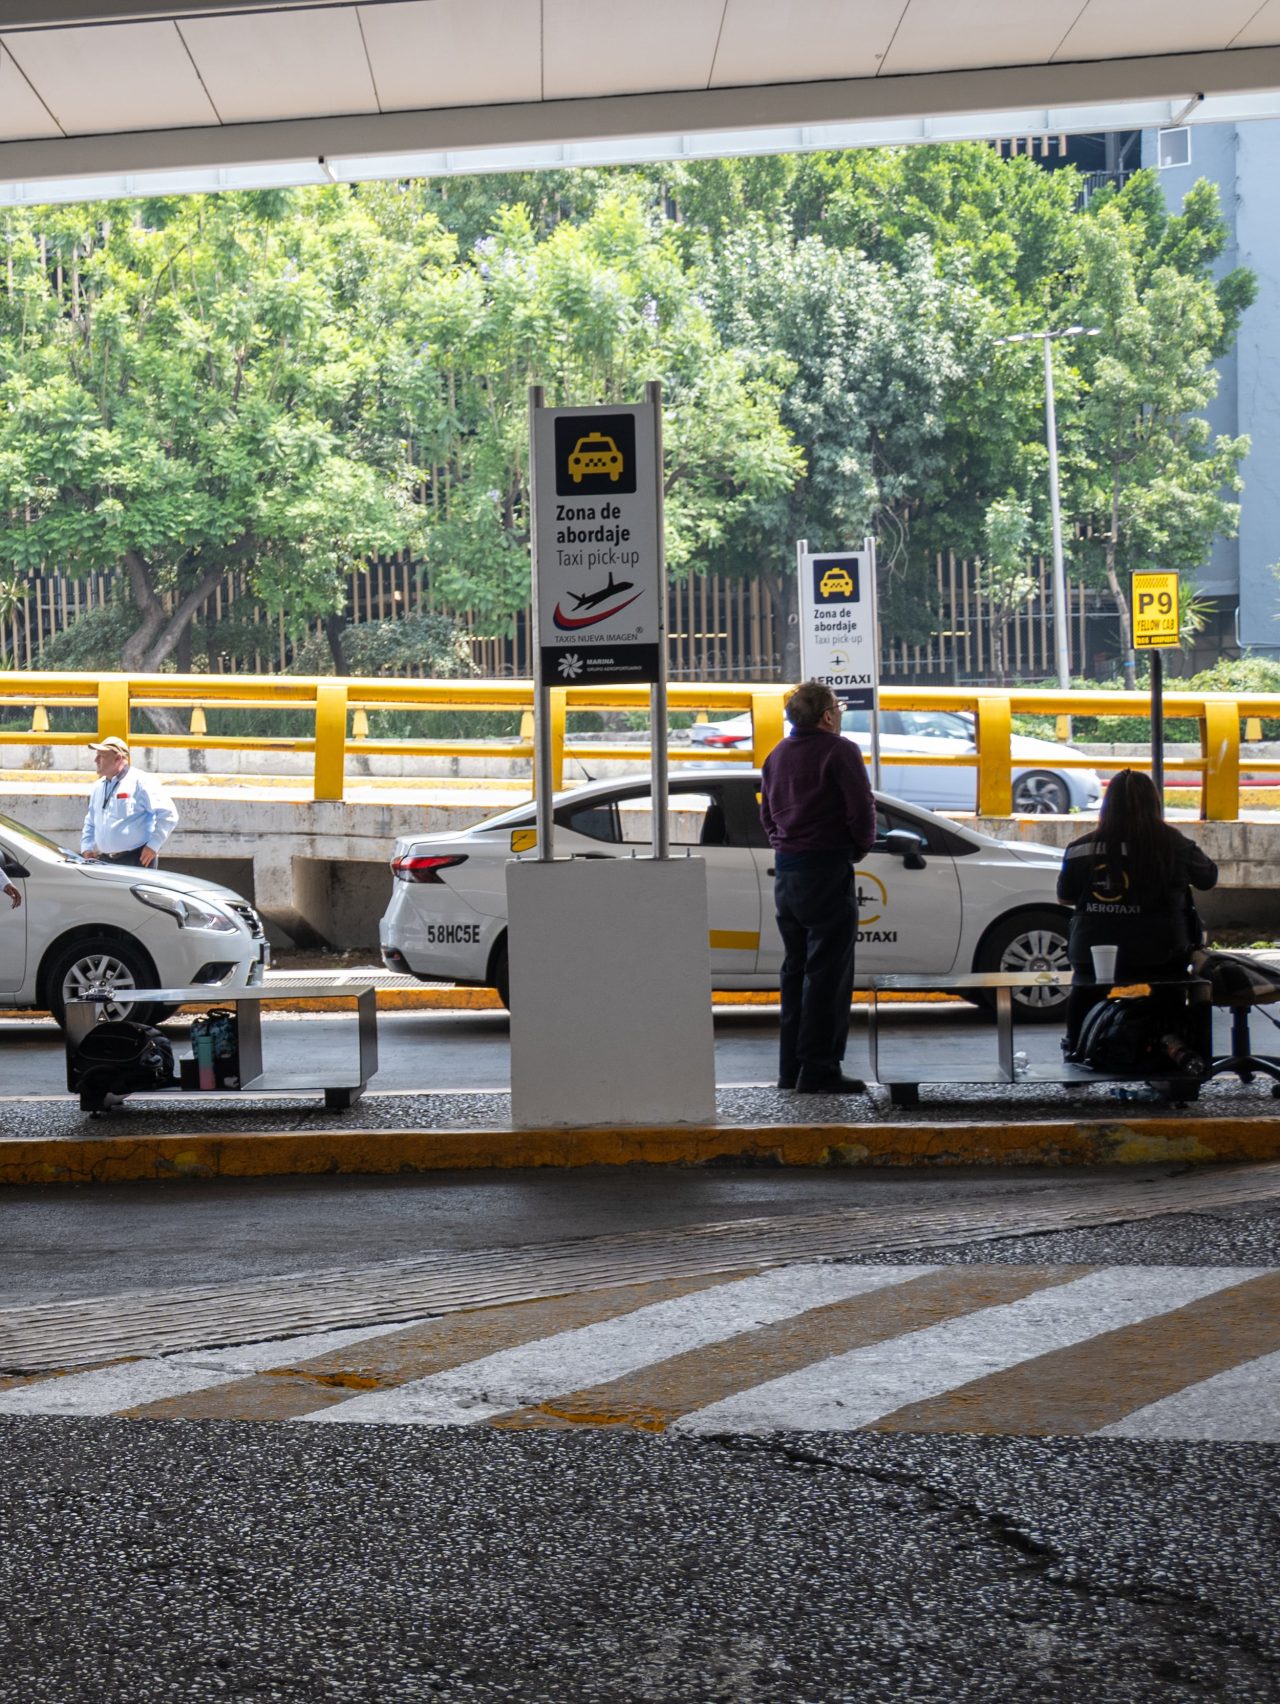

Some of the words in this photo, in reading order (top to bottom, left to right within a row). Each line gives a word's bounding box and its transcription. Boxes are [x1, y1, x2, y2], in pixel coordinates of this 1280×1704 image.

[556, 505, 596, 521] Zona
[600, 502, 621, 520] de
[556, 524, 631, 547] abordaje
[556, 549, 583, 567] Taxi
[588, 547, 640, 570] pick-up
[814, 609, 837, 619] Zona
[839, 608, 852, 618] de
[814, 620, 857, 633] abordaje
[1162, 618, 1175, 631] CAB
[555, 635, 577, 644] TAXIS
[578, 634, 605, 643] NUEVA
[606, 633, 638, 642] IMAGEN
[814, 634, 831, 645] Taxi
[832, 633, 863, 646] pick-up
[1086, 902, 1141, 914] AEROTAXI
[427, 924, 481, 944] 58HC5E
[856, 931, 898, 943] OTAXI
